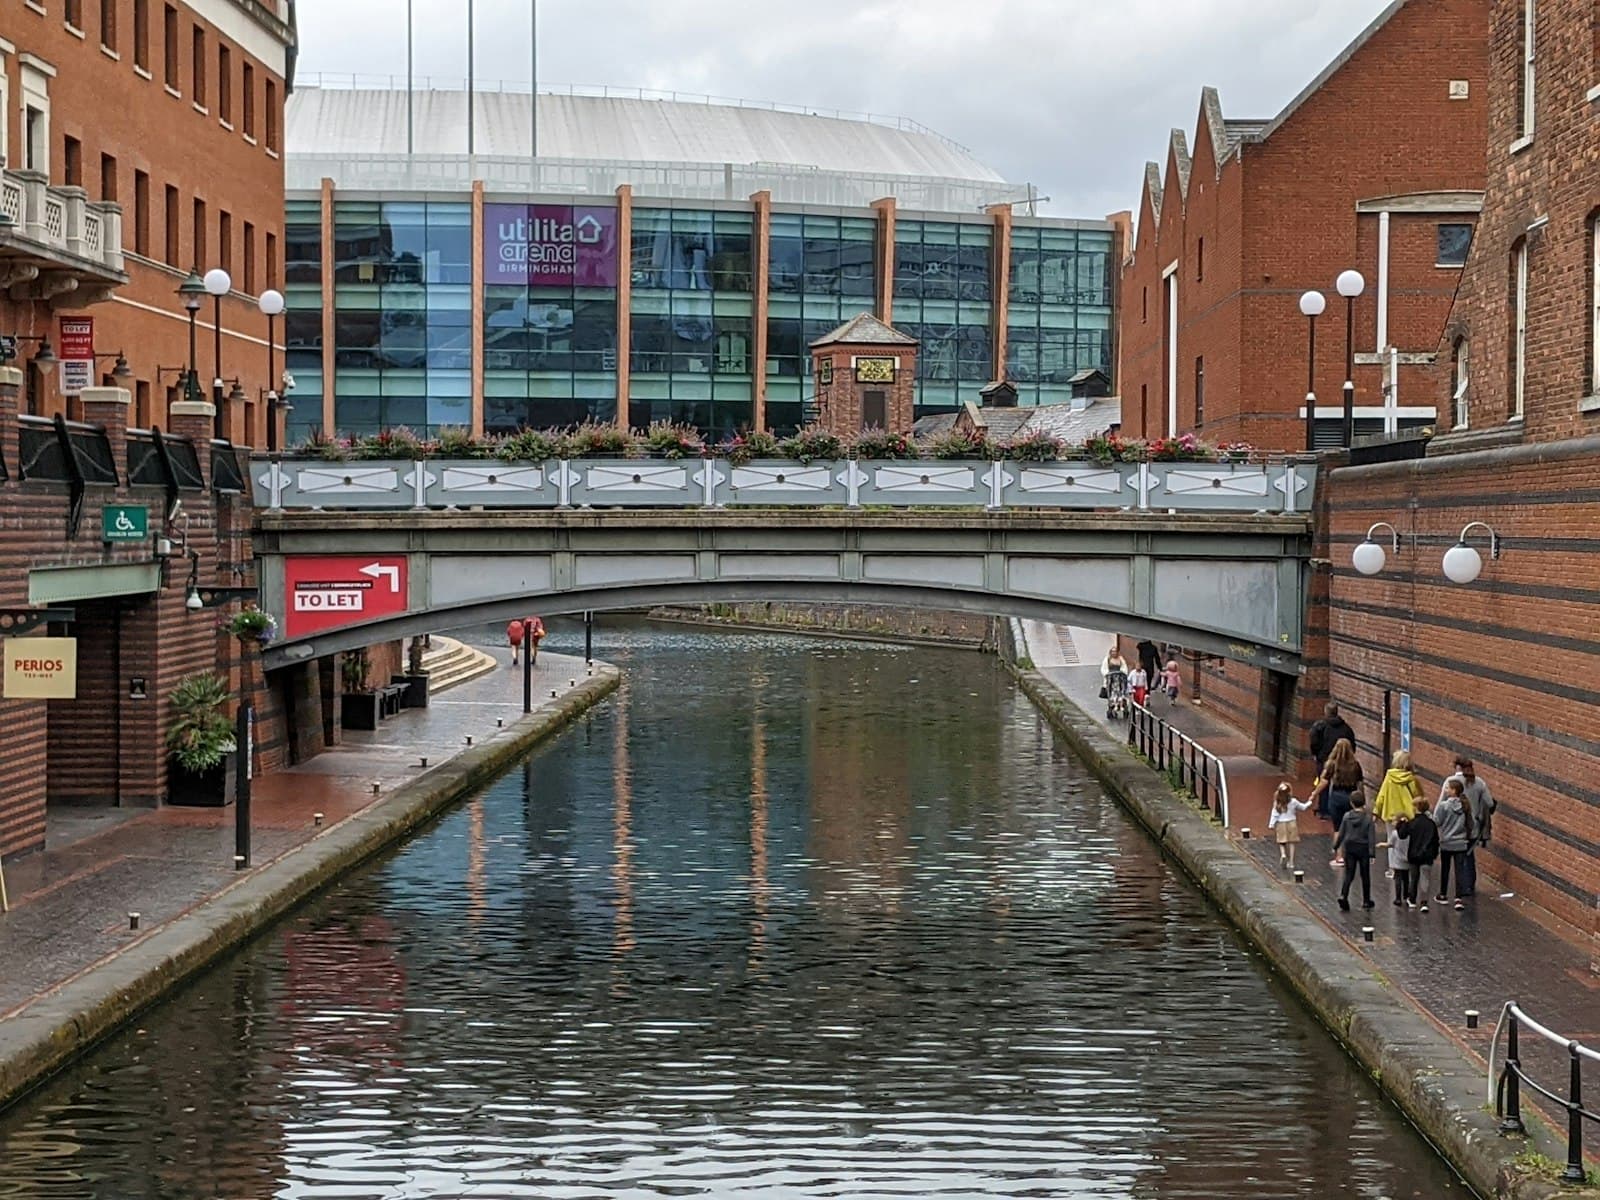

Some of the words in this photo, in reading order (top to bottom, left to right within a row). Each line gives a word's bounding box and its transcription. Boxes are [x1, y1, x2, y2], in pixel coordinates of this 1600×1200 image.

[499, 217, 576, 242] utilita
[499, 242, 577, 263] arena
[498, 263, 577, 274] BIRMINGHAM
[298, 594, 322, 606] TO
[327, 594, 358, 606] LET
[14, 659, 63, 671] PERIOS
